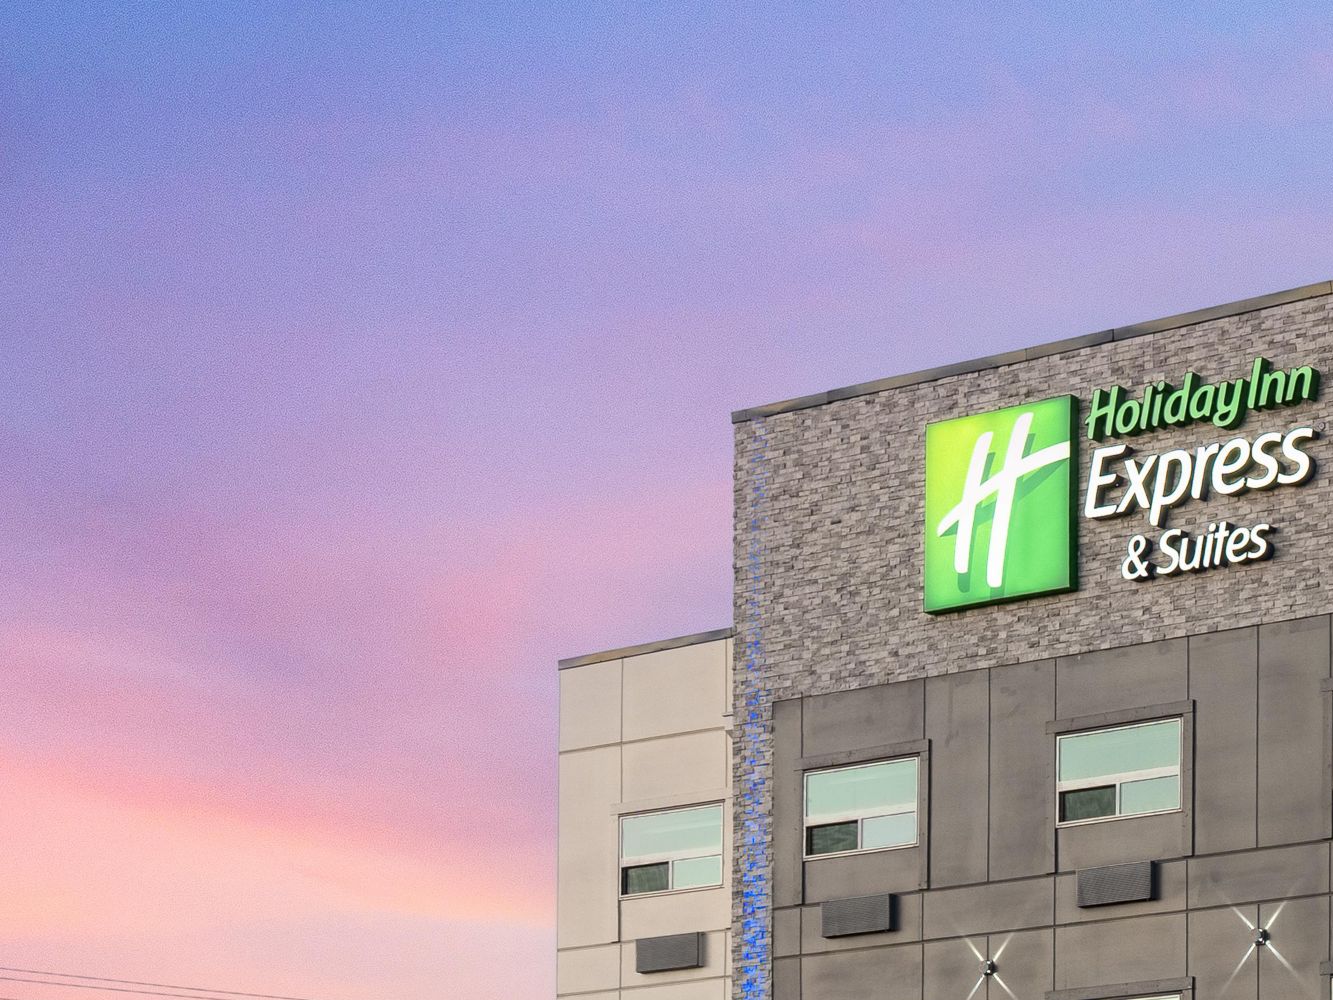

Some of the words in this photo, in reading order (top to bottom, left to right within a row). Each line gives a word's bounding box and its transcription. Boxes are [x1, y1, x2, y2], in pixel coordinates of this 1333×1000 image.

[1084, 427, 1314, 527] Express
[1121, 534, 1149, 580] &
[1156, 522, 1270, 575] Suites
